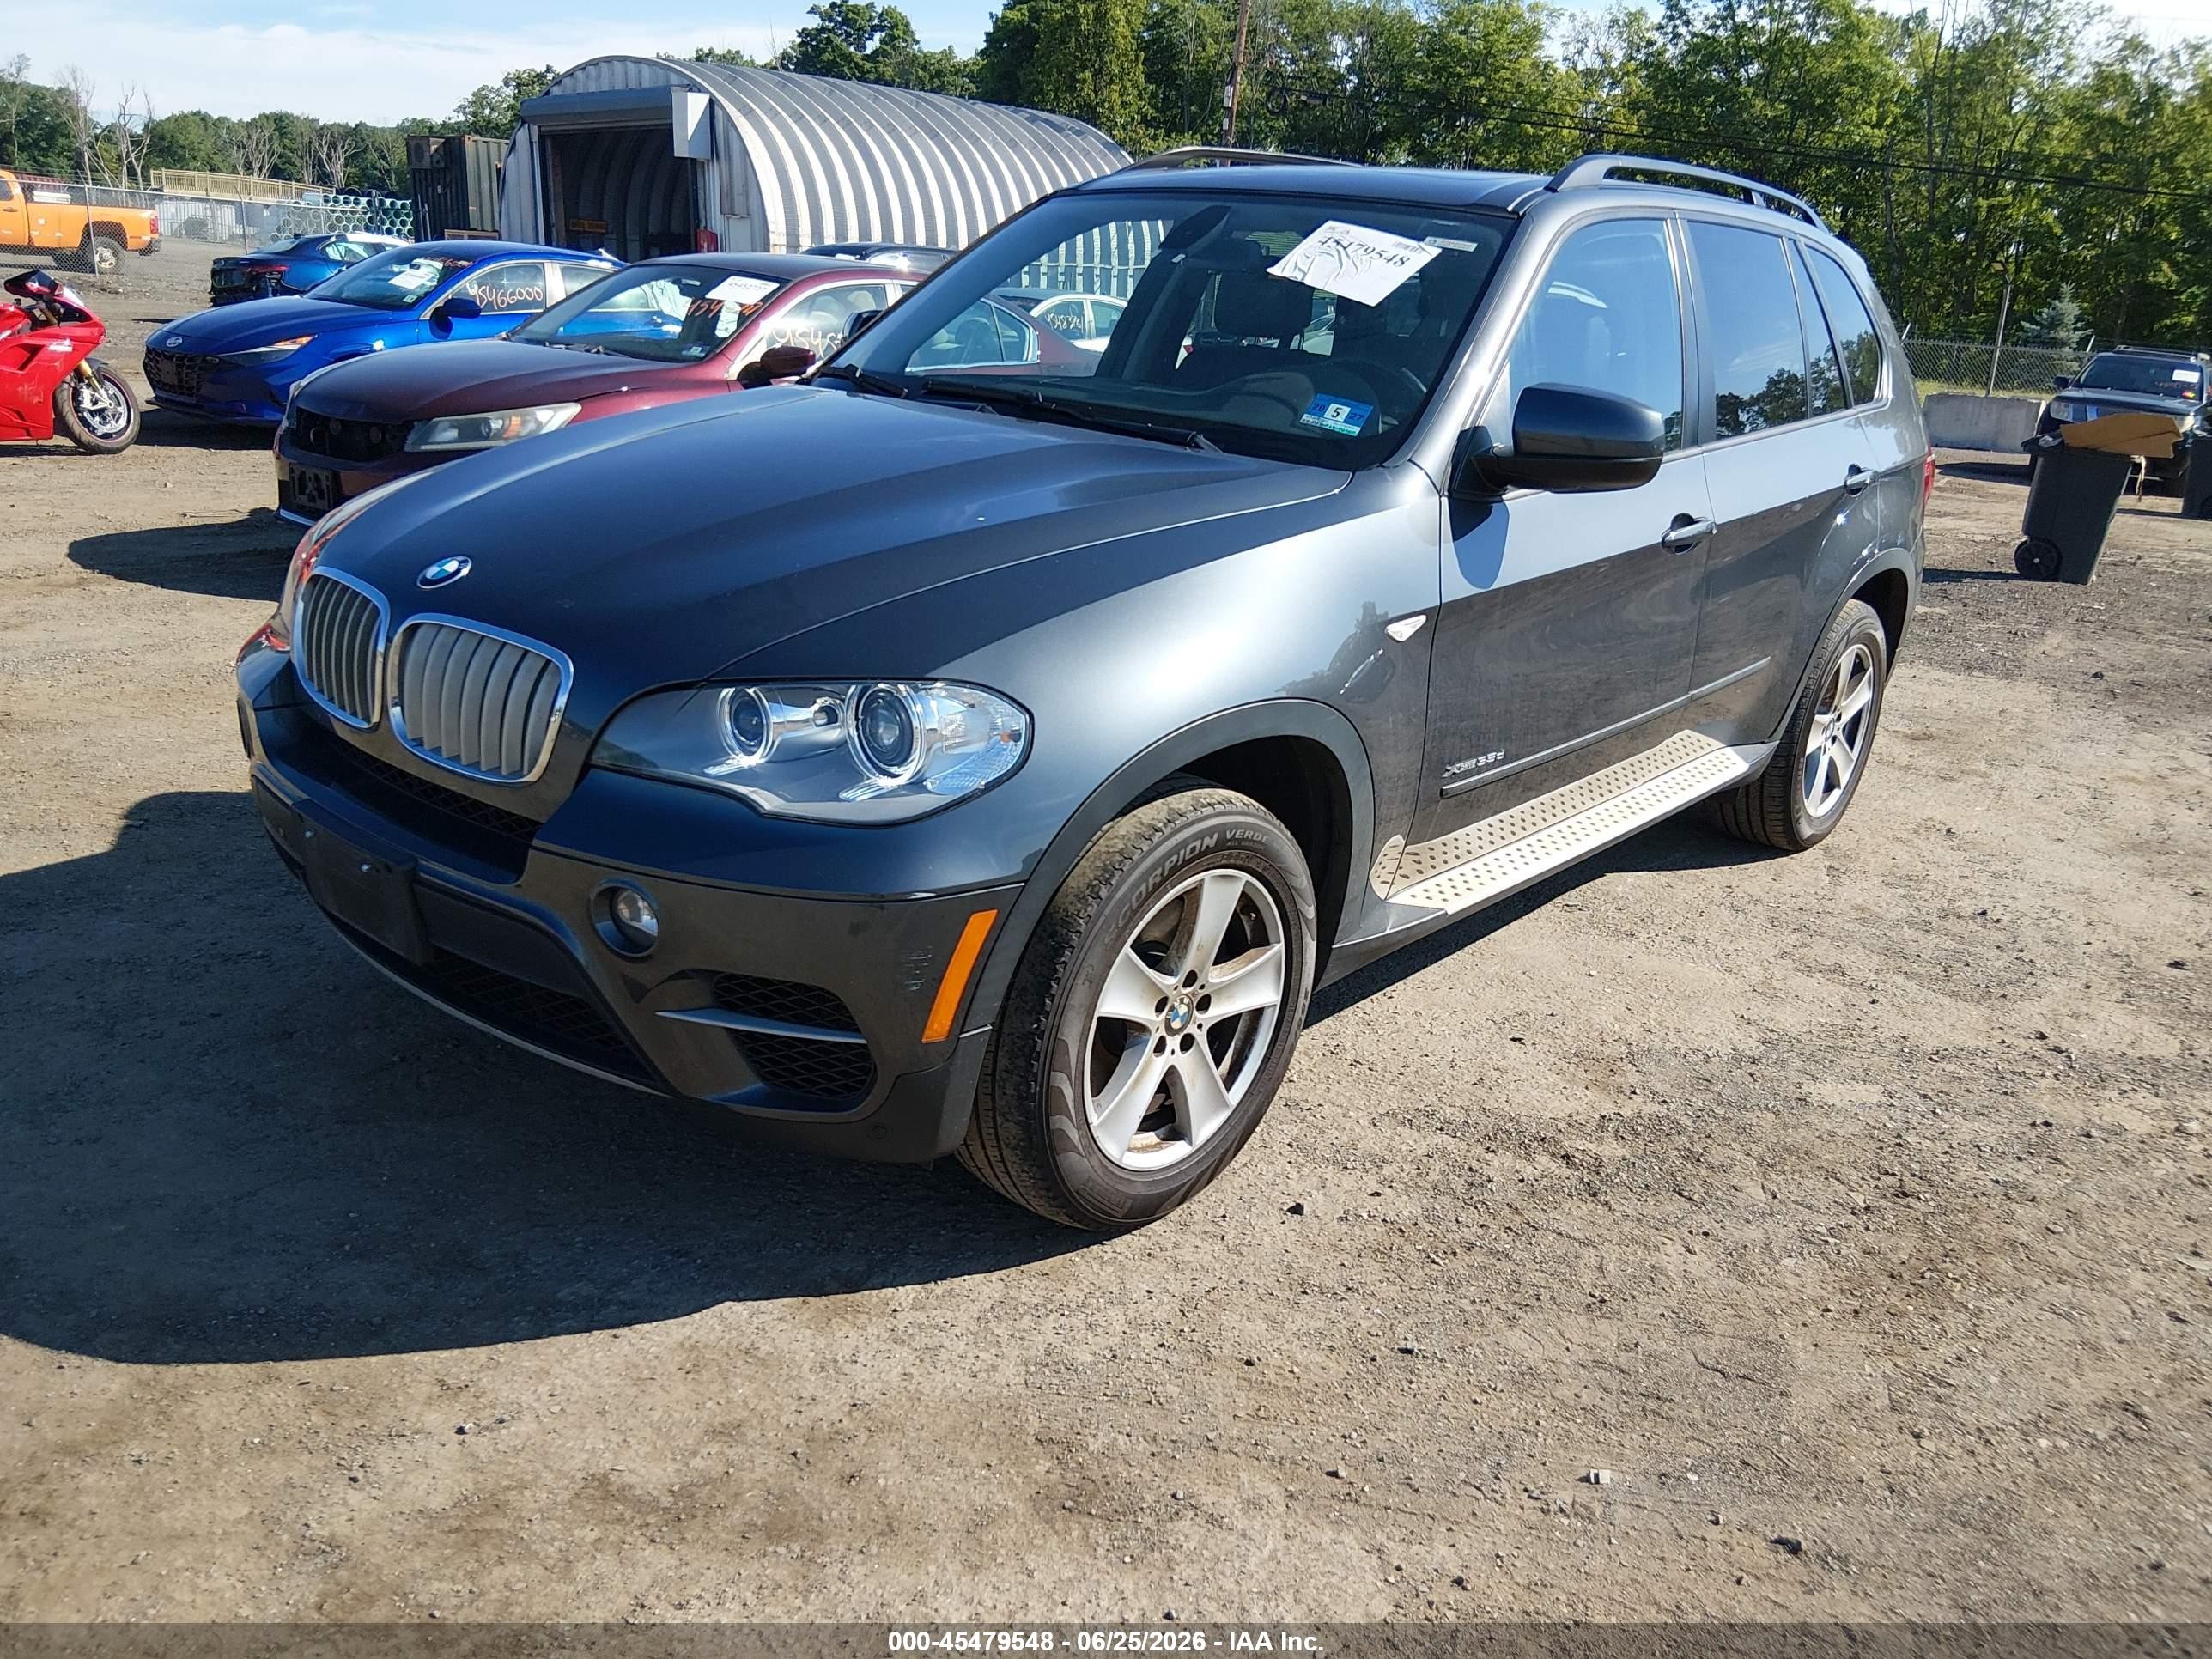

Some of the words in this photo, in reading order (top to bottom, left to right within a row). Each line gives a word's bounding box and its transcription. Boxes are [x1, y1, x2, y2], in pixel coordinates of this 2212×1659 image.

[466, 279, 544, 310] 45466000
[1331, 407, 1341, 418] 5
[1225, 829, 1271, 845] VERDE
